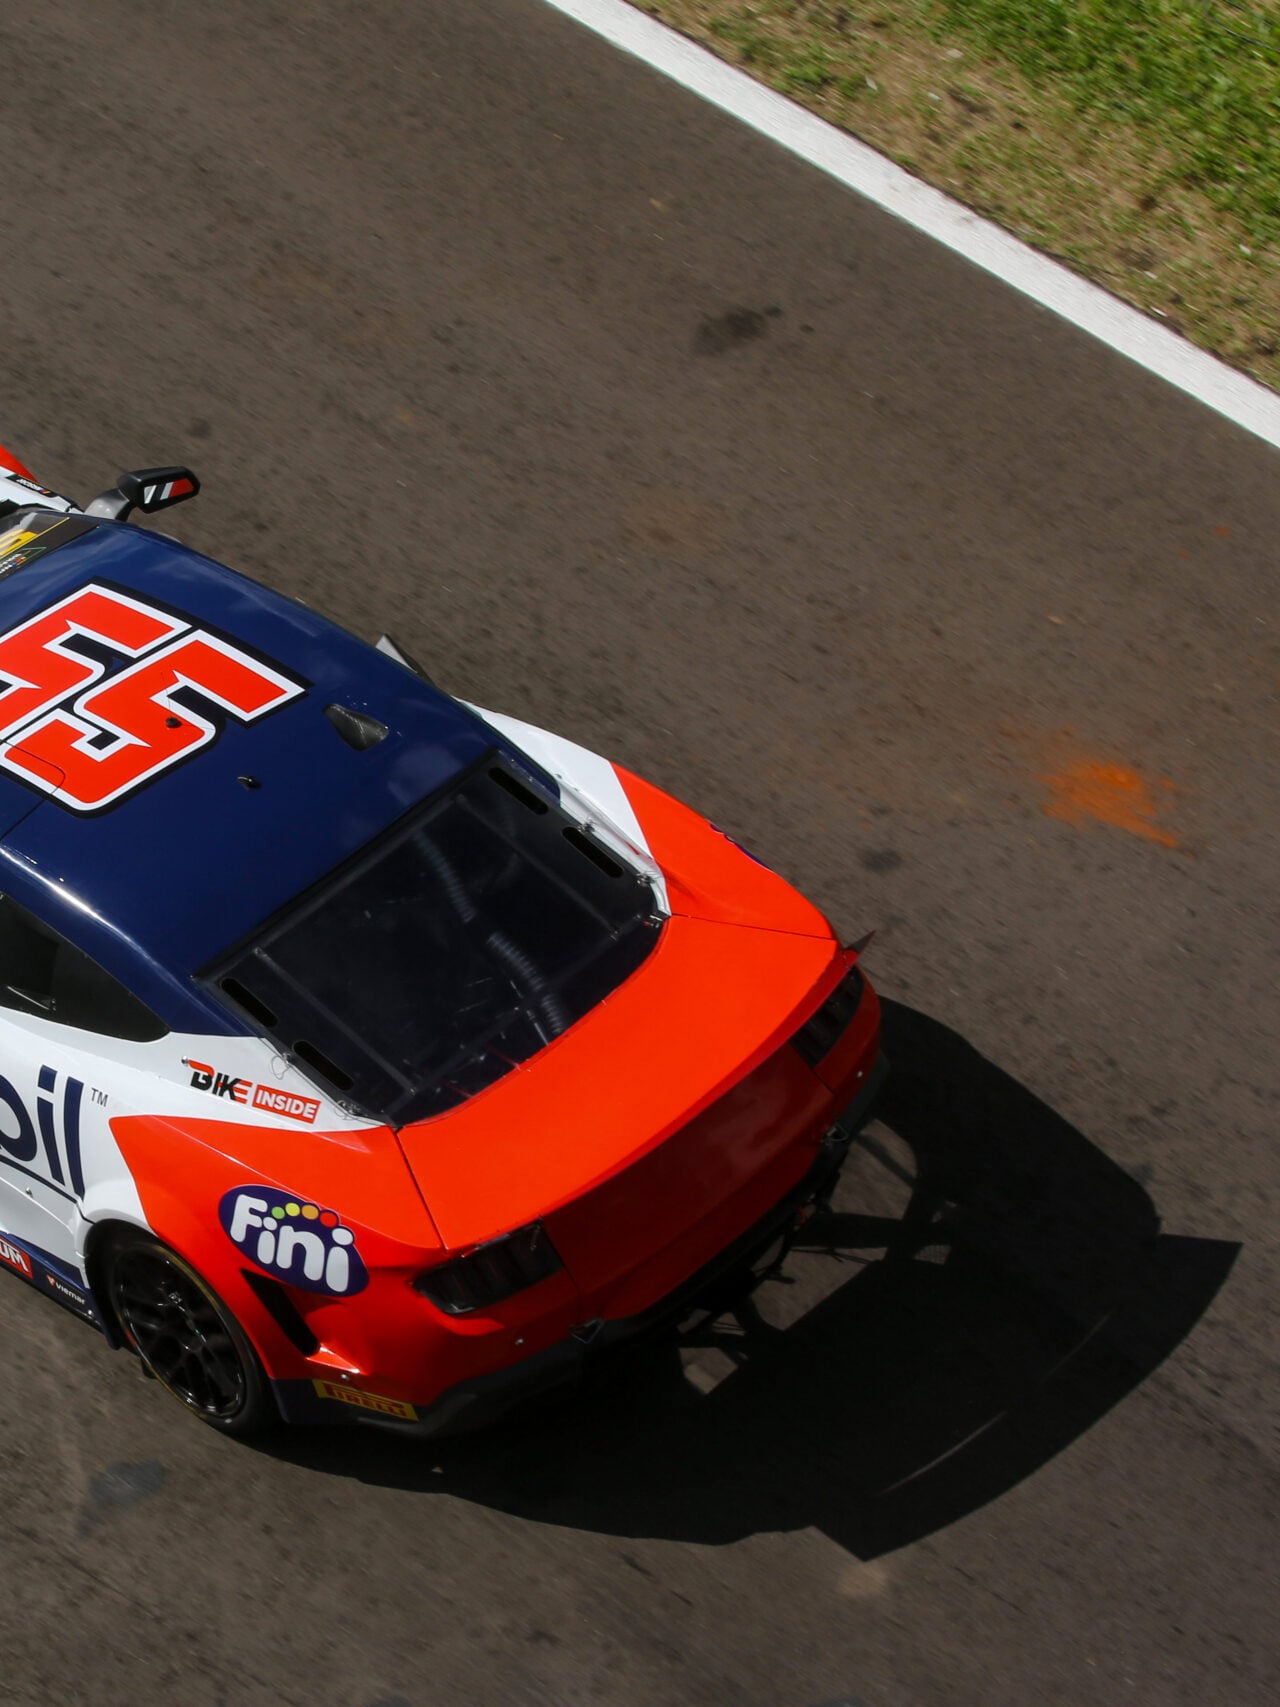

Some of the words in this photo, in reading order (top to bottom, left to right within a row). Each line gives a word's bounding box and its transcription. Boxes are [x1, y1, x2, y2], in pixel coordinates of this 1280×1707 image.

[90, 1087, 109, 1107] TM
[188, 1059, 253, 1105] BIKE
[255, 1089, 317, 1119] INSIDE
[228, 1194, 352, 1293] Fini
[55, 1281, 85, 1304] viemar
[322, 1381, 407, 1417] PIRELLI
